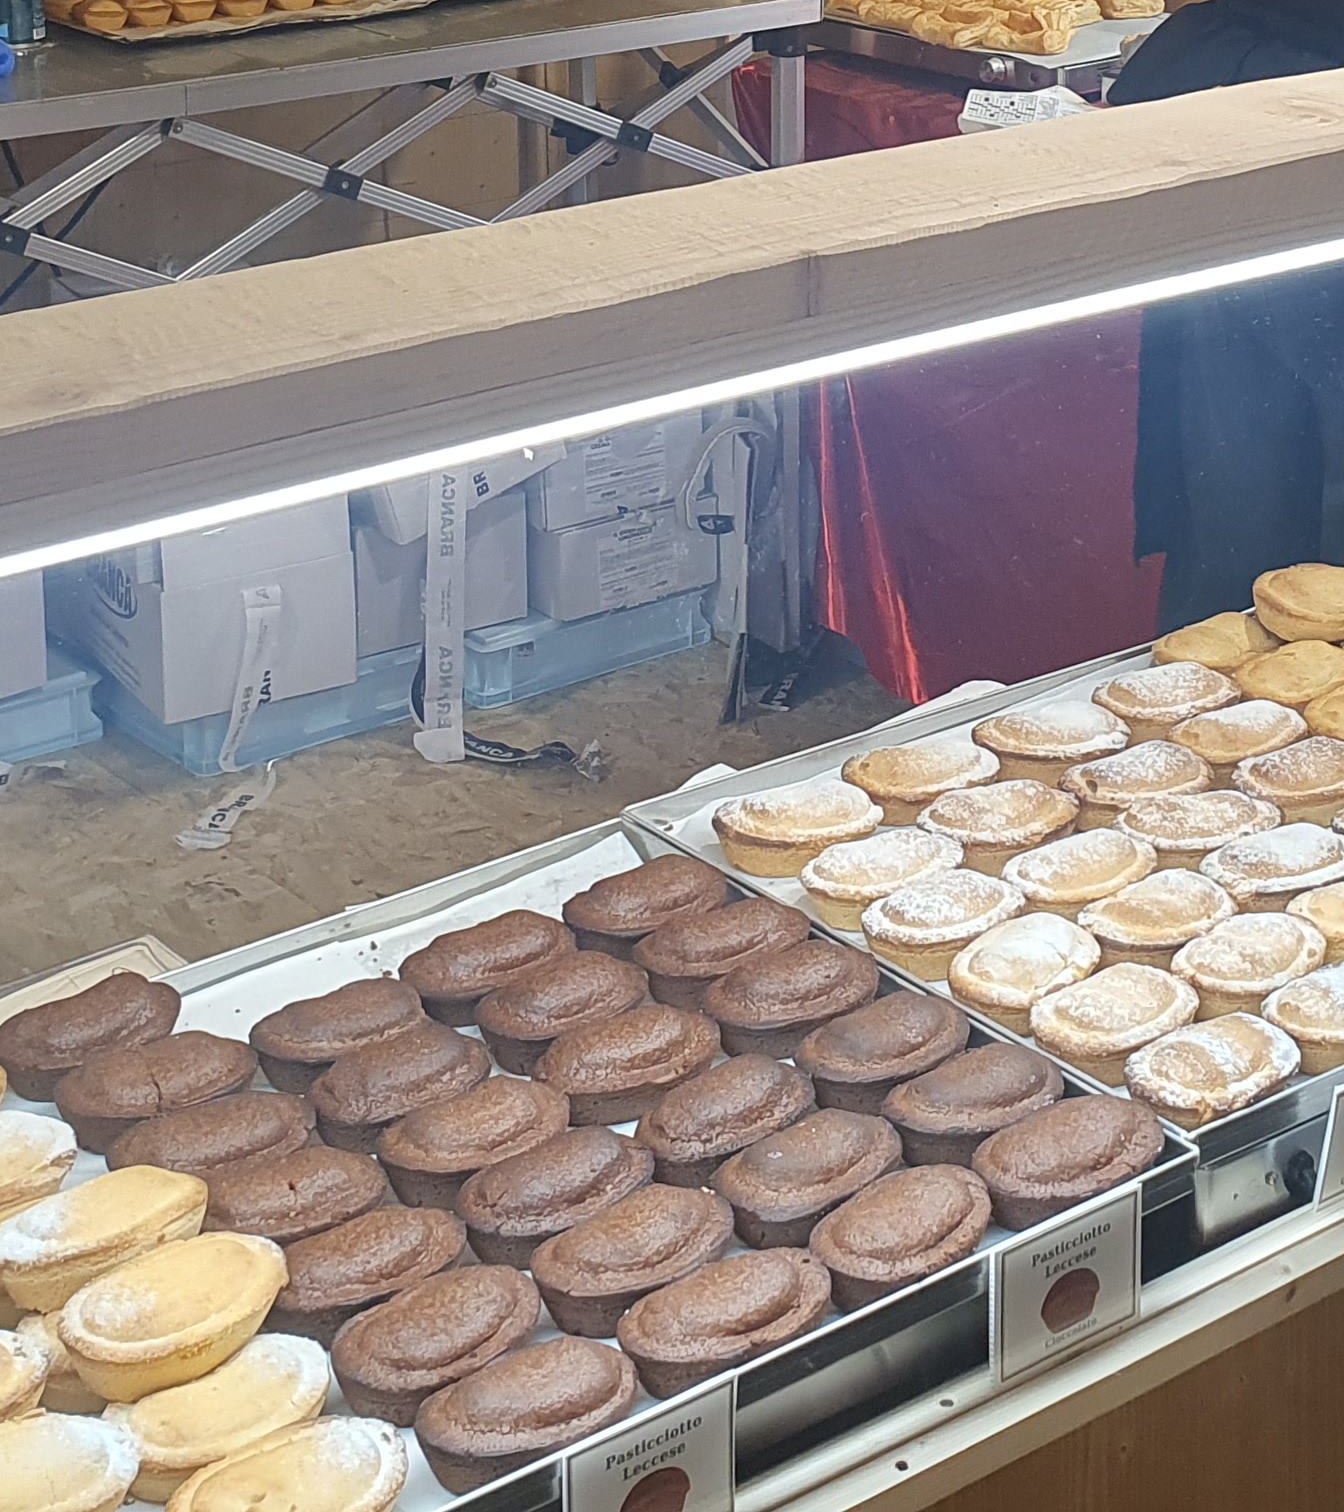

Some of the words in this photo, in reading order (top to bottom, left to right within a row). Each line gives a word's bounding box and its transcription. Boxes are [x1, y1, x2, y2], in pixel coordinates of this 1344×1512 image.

[466, 737, 513, 758] ANCA
[1031, 1222, 1111, 1268] Pasticciotto
[1045, 1246, 1097, 1279] Leccese
[1044, 1317, 1097, 1350] Cioccolato
[605, 1416, 702, 1471] Pasticciotto
[622, 1442, 686, 1481] Leccese
